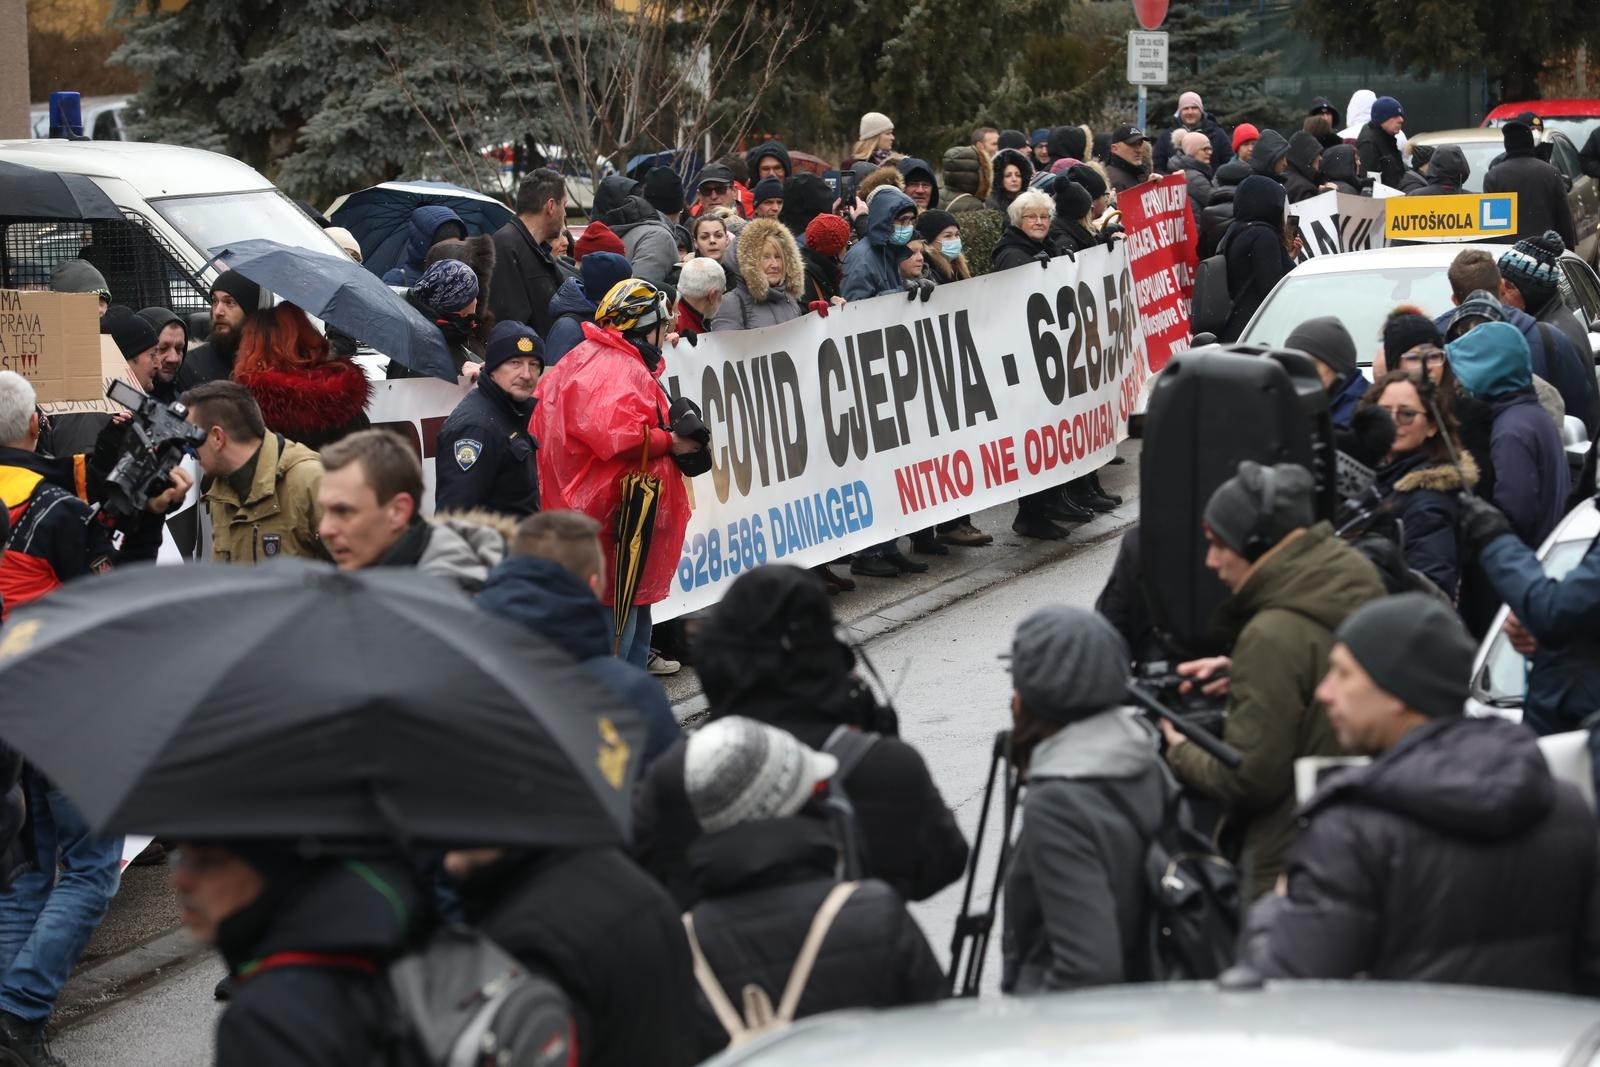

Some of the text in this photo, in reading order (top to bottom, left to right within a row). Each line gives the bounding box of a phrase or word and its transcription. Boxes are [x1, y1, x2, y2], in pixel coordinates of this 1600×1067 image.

[1391, 211, 1473, 231] AUTOŠKOLA
[1, 313, 42, 333] PRAVA
[12, 333, 46, 354] TEST
[701, 350, 808, 505] COVID
[817, 309, 998, 468] CJEPIVA
[894, 400, 1115, 515] NITKO NE ODGOVARA
[677, 480, 874, 592] 628.586 DAMAGED
